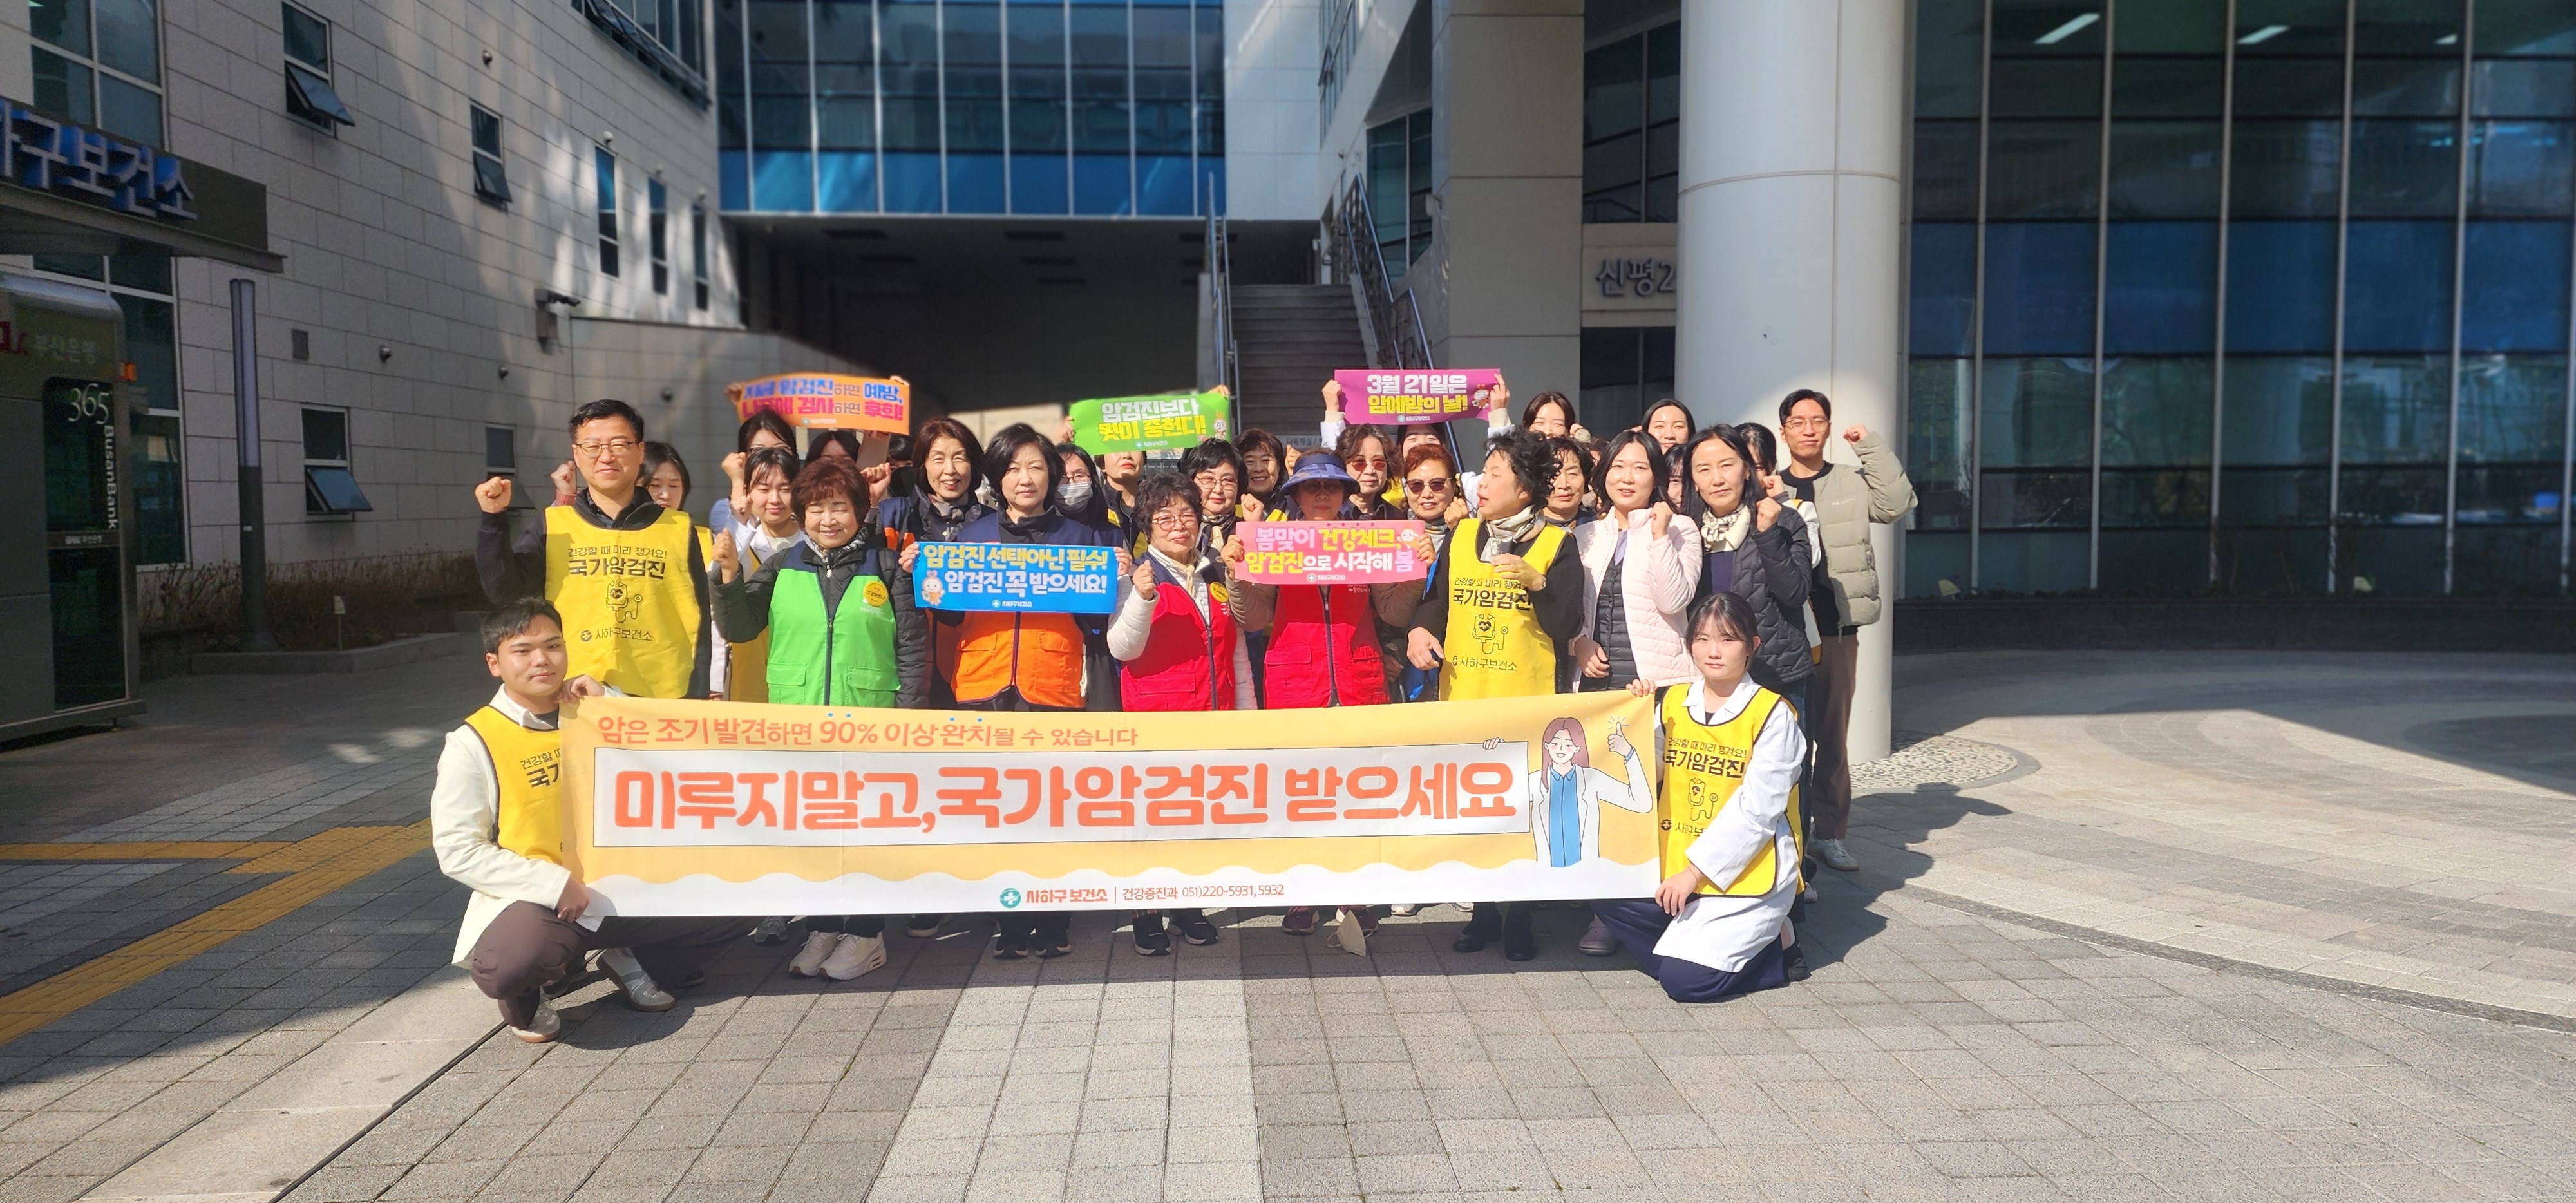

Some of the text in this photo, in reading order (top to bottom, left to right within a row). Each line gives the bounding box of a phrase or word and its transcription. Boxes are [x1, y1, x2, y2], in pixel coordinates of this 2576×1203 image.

[1596, 258, 1674, 298] 신평2
[779, 377, 860, 397] 암검진하면
[864, 383, 903, 404] 예방,
[1367, 374, 1467, 394] 3월 21일은
[68, 383, 110, 425] 365
[797, 397, 860, 415] 검사하면
[864, 400, 903, 421] 후회!
[1101, 397, 1200, 423] 암검진보다
[1368, 394, 1469, 414] 암예방의 날!
[1099, 415, 1207, 442] 뭣이 중헌디!
[104, 425, 118, 529] BusanBank
[1255, 527, 1401, 551] 봄맞이 건강체크,
[567, 545, 668, 560] 건강할 때 미리 챙겨요!
[923, 544, 1110, 572] 암검진 선택아닌 필수!
[1244, 549, 1414, 574] 암검진으로 시작해 봄
[568, 556, 667, 580] 국가암검진
[944, 570, 1108, 598] 암검진 꼭 받으세요!
[1485, 579, 1502, 589] 미리
[1453, 588, 1531, 611] 국가암검진
[594, 627, 654, 642] 사하구보건소
[1459, 656, 1518, 672] 사하구보건소
[597, 715, 649, 744] 암은
[655, 717, 709, 744] 조기
[713, 717, 813, 746] 발견하면
[819, 721, 878, 744] 90%
[1021, 728, 1045, 746] 수
[1050, 728, 1138, 746] 있습니다
[1668, 737, 1689, 748] 건강할
[1700, 742, 1716, 753] 미리
[1718, 744, 1747, 759] 챙겨요!
[520, 752, 554, 770] 건강할
[1665, 749, 1747, 779] 국가암검진
[1284, 762, 1516, 822] 받으세요
[1026, 889, 1067, 904] 사하구
[1069, 889, 1108, 903] 보건소
[1122, 887, 1178, 901] 건강증진과
